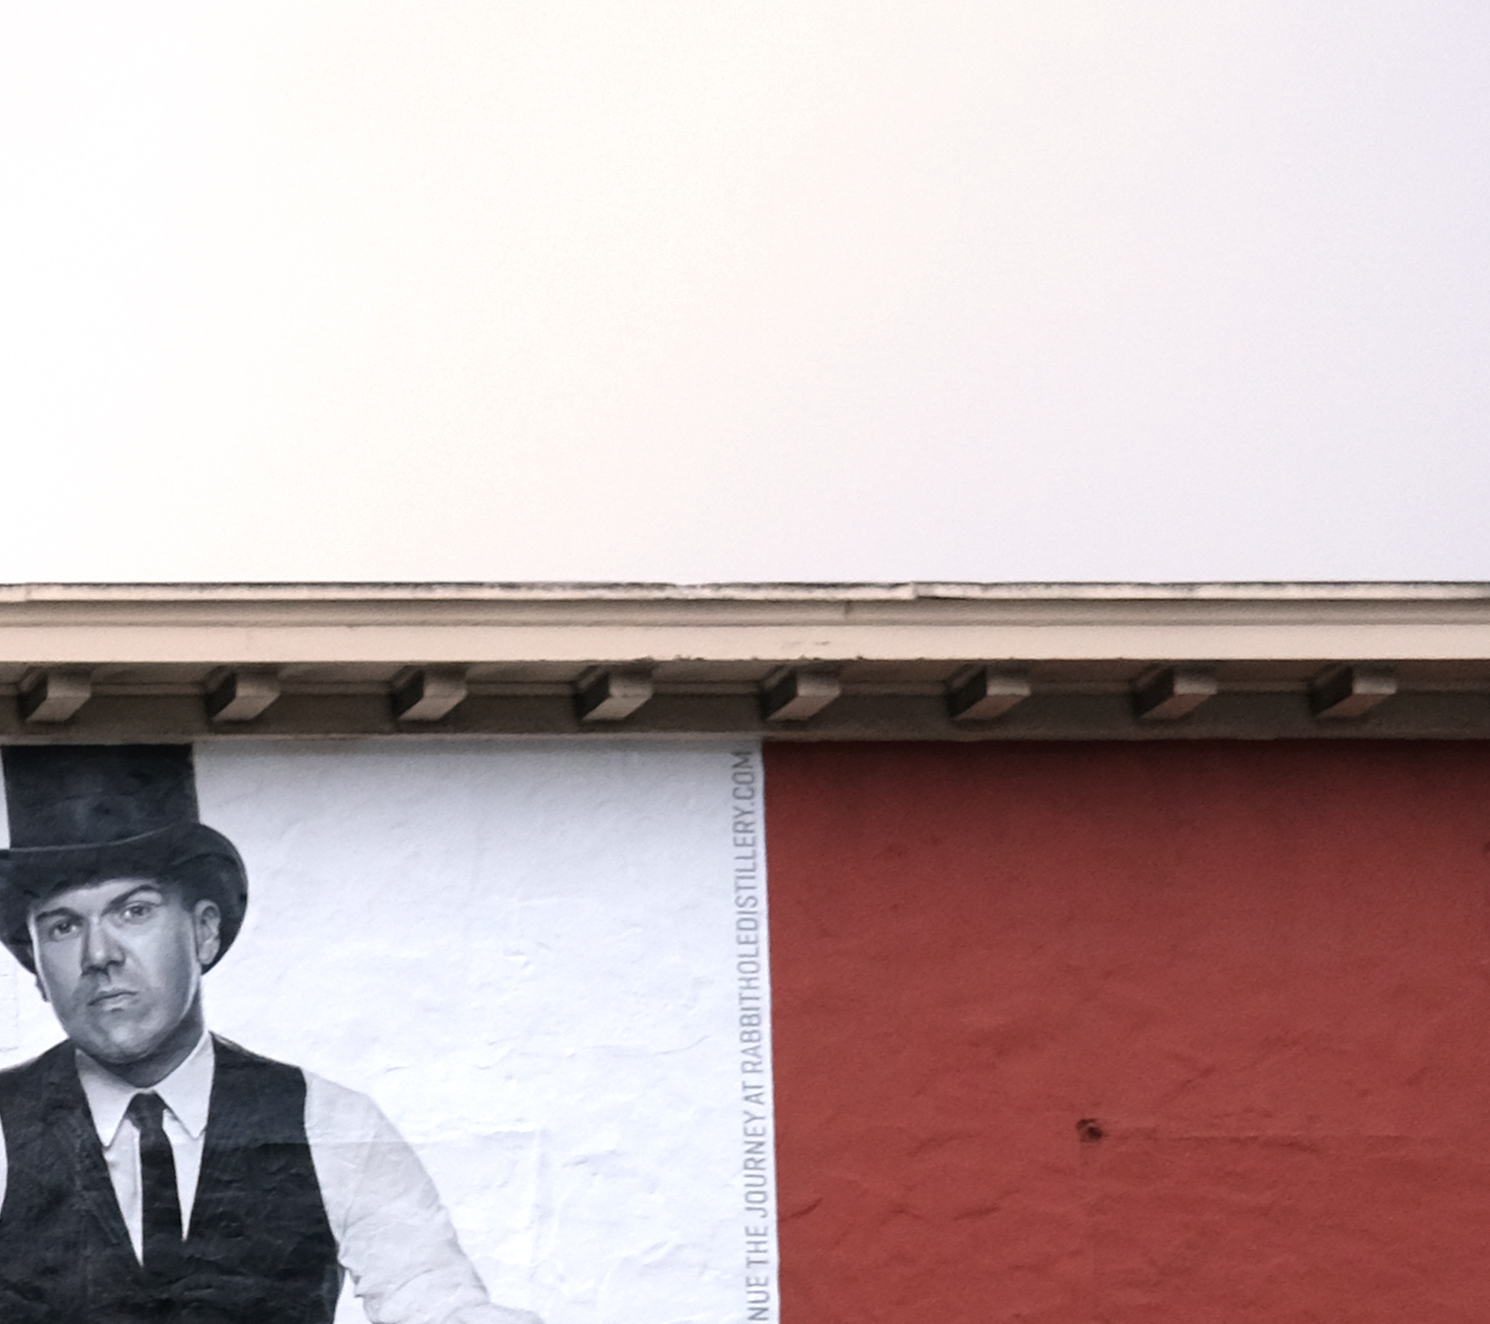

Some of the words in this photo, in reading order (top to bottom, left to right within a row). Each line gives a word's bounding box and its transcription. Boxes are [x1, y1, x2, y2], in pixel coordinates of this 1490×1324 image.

[732, 749, 763, 1076] RABBITHOLEDISTILLERY.COM
[742, 1081, 766, 1107] AT
[743, 1109, 769, 1219] JOURNEY
[745, 1226, 770, 1270] THE
